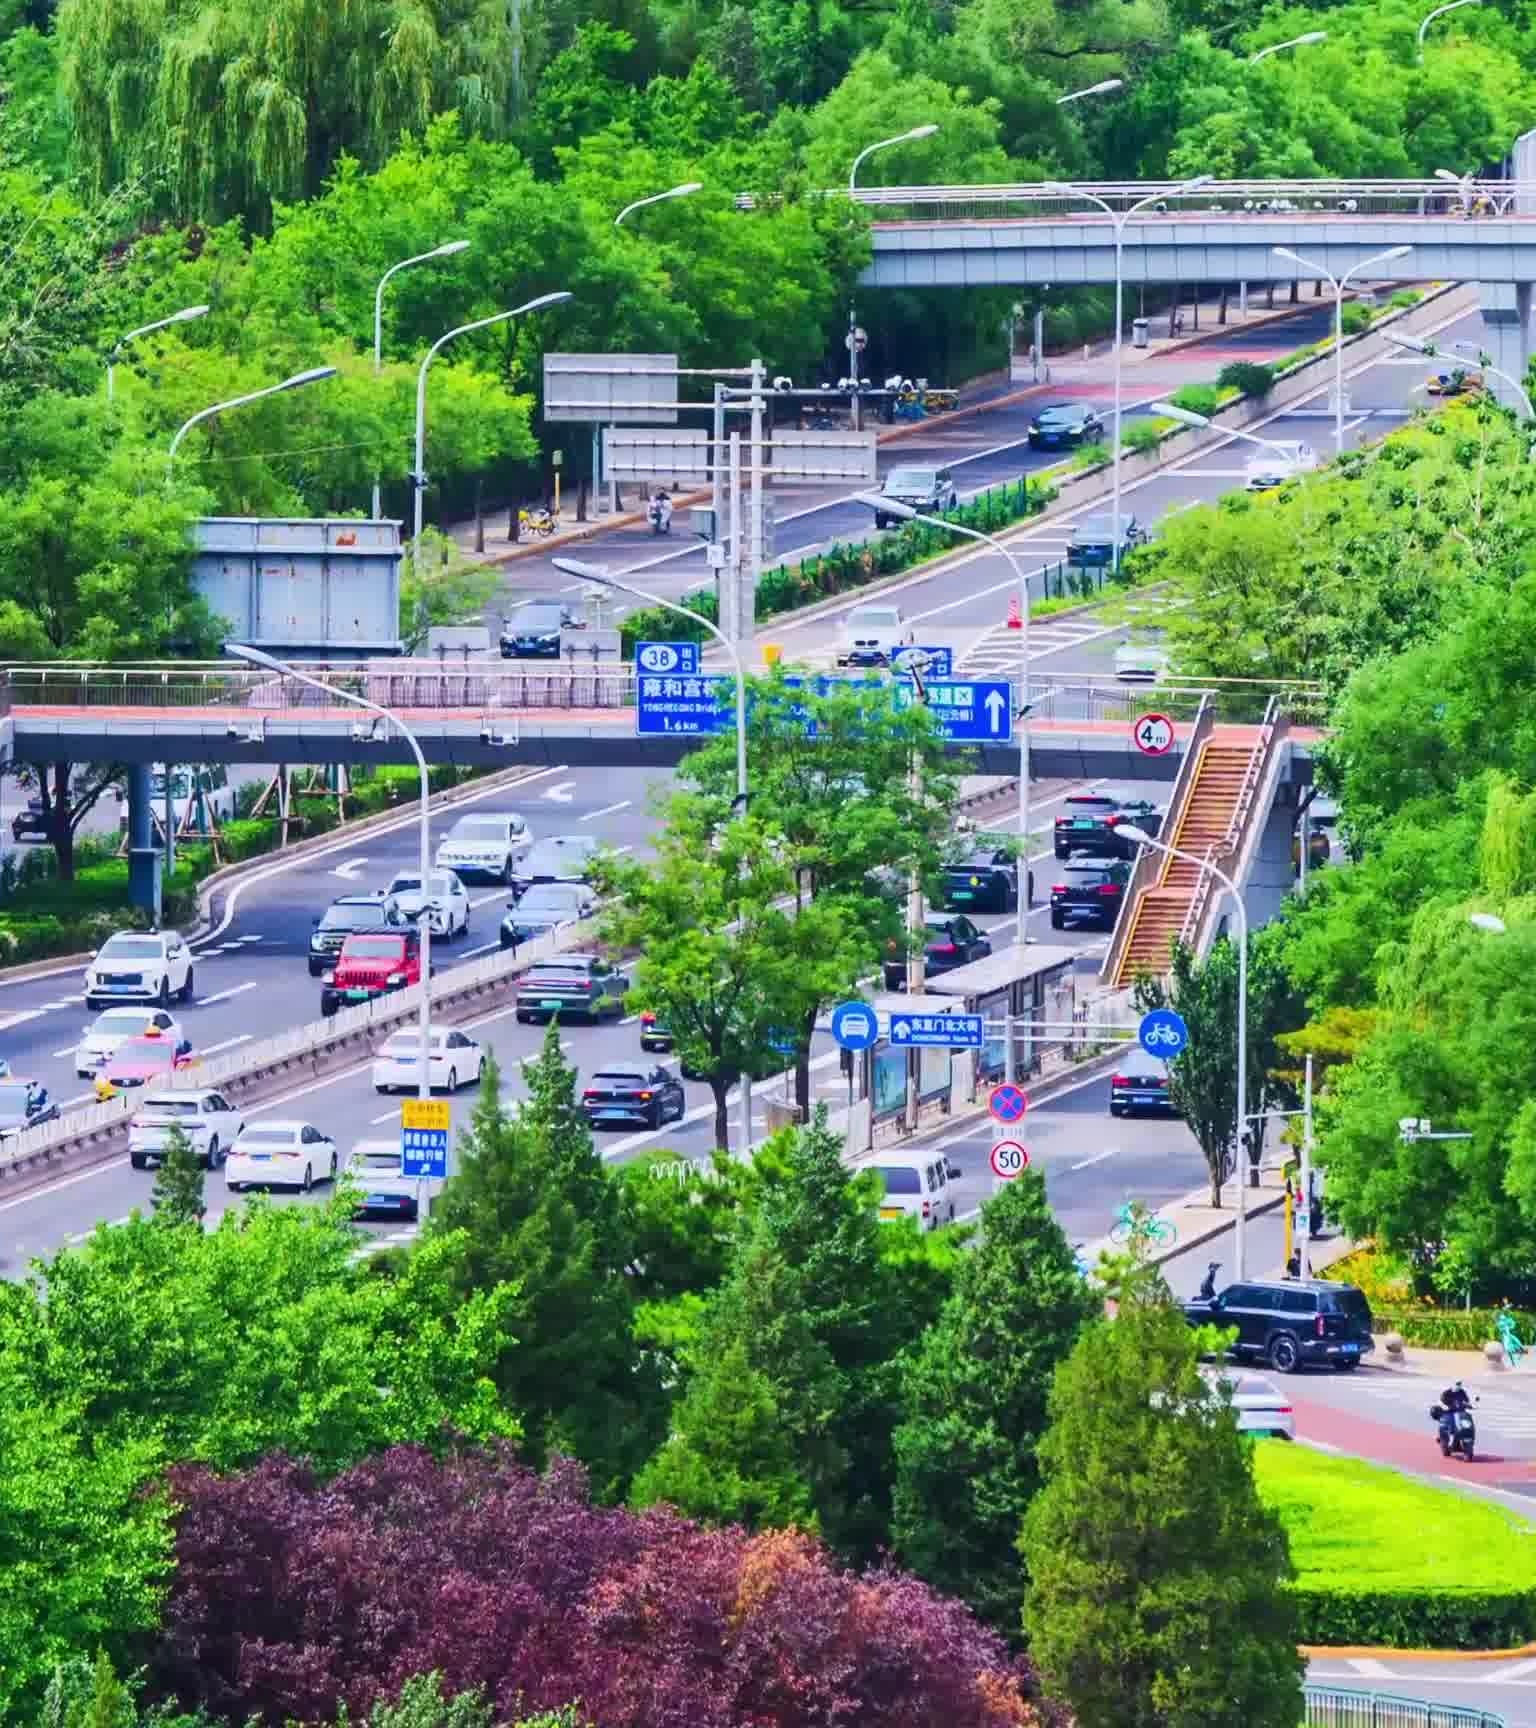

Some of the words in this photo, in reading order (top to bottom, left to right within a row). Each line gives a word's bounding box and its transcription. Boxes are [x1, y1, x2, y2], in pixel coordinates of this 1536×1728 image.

[648, 650, 670, 666] 38
[681, 647, 693, 671] 出口
[999, 1151, 1021, 1169] 50
